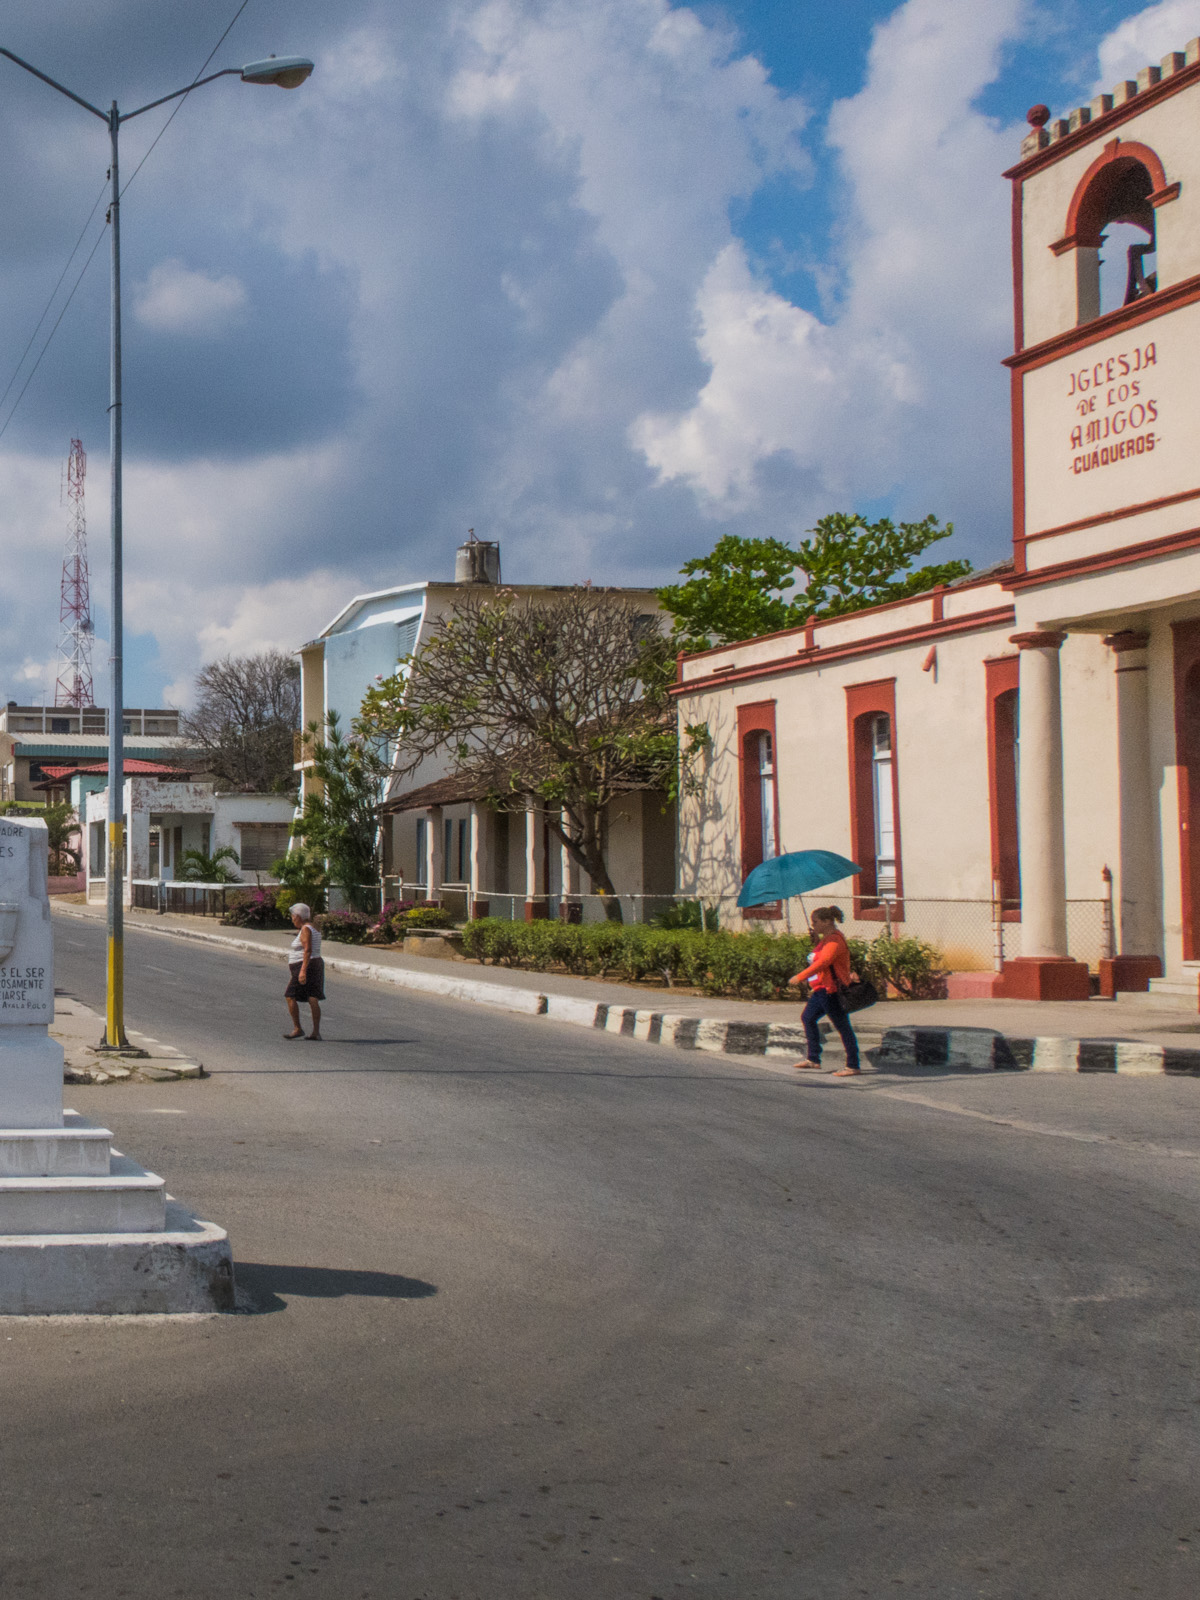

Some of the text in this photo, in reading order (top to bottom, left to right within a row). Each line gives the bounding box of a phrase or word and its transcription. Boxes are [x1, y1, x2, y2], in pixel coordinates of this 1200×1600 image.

[1067, 341, 1157, 397] IGLESIA
[1076, 380, 1140, 417] DE LOS
[1069, 399, 1158, 450] AMIGOS
[10, 967, 22, 978] EL
[25, 967, 45, 978] SER
